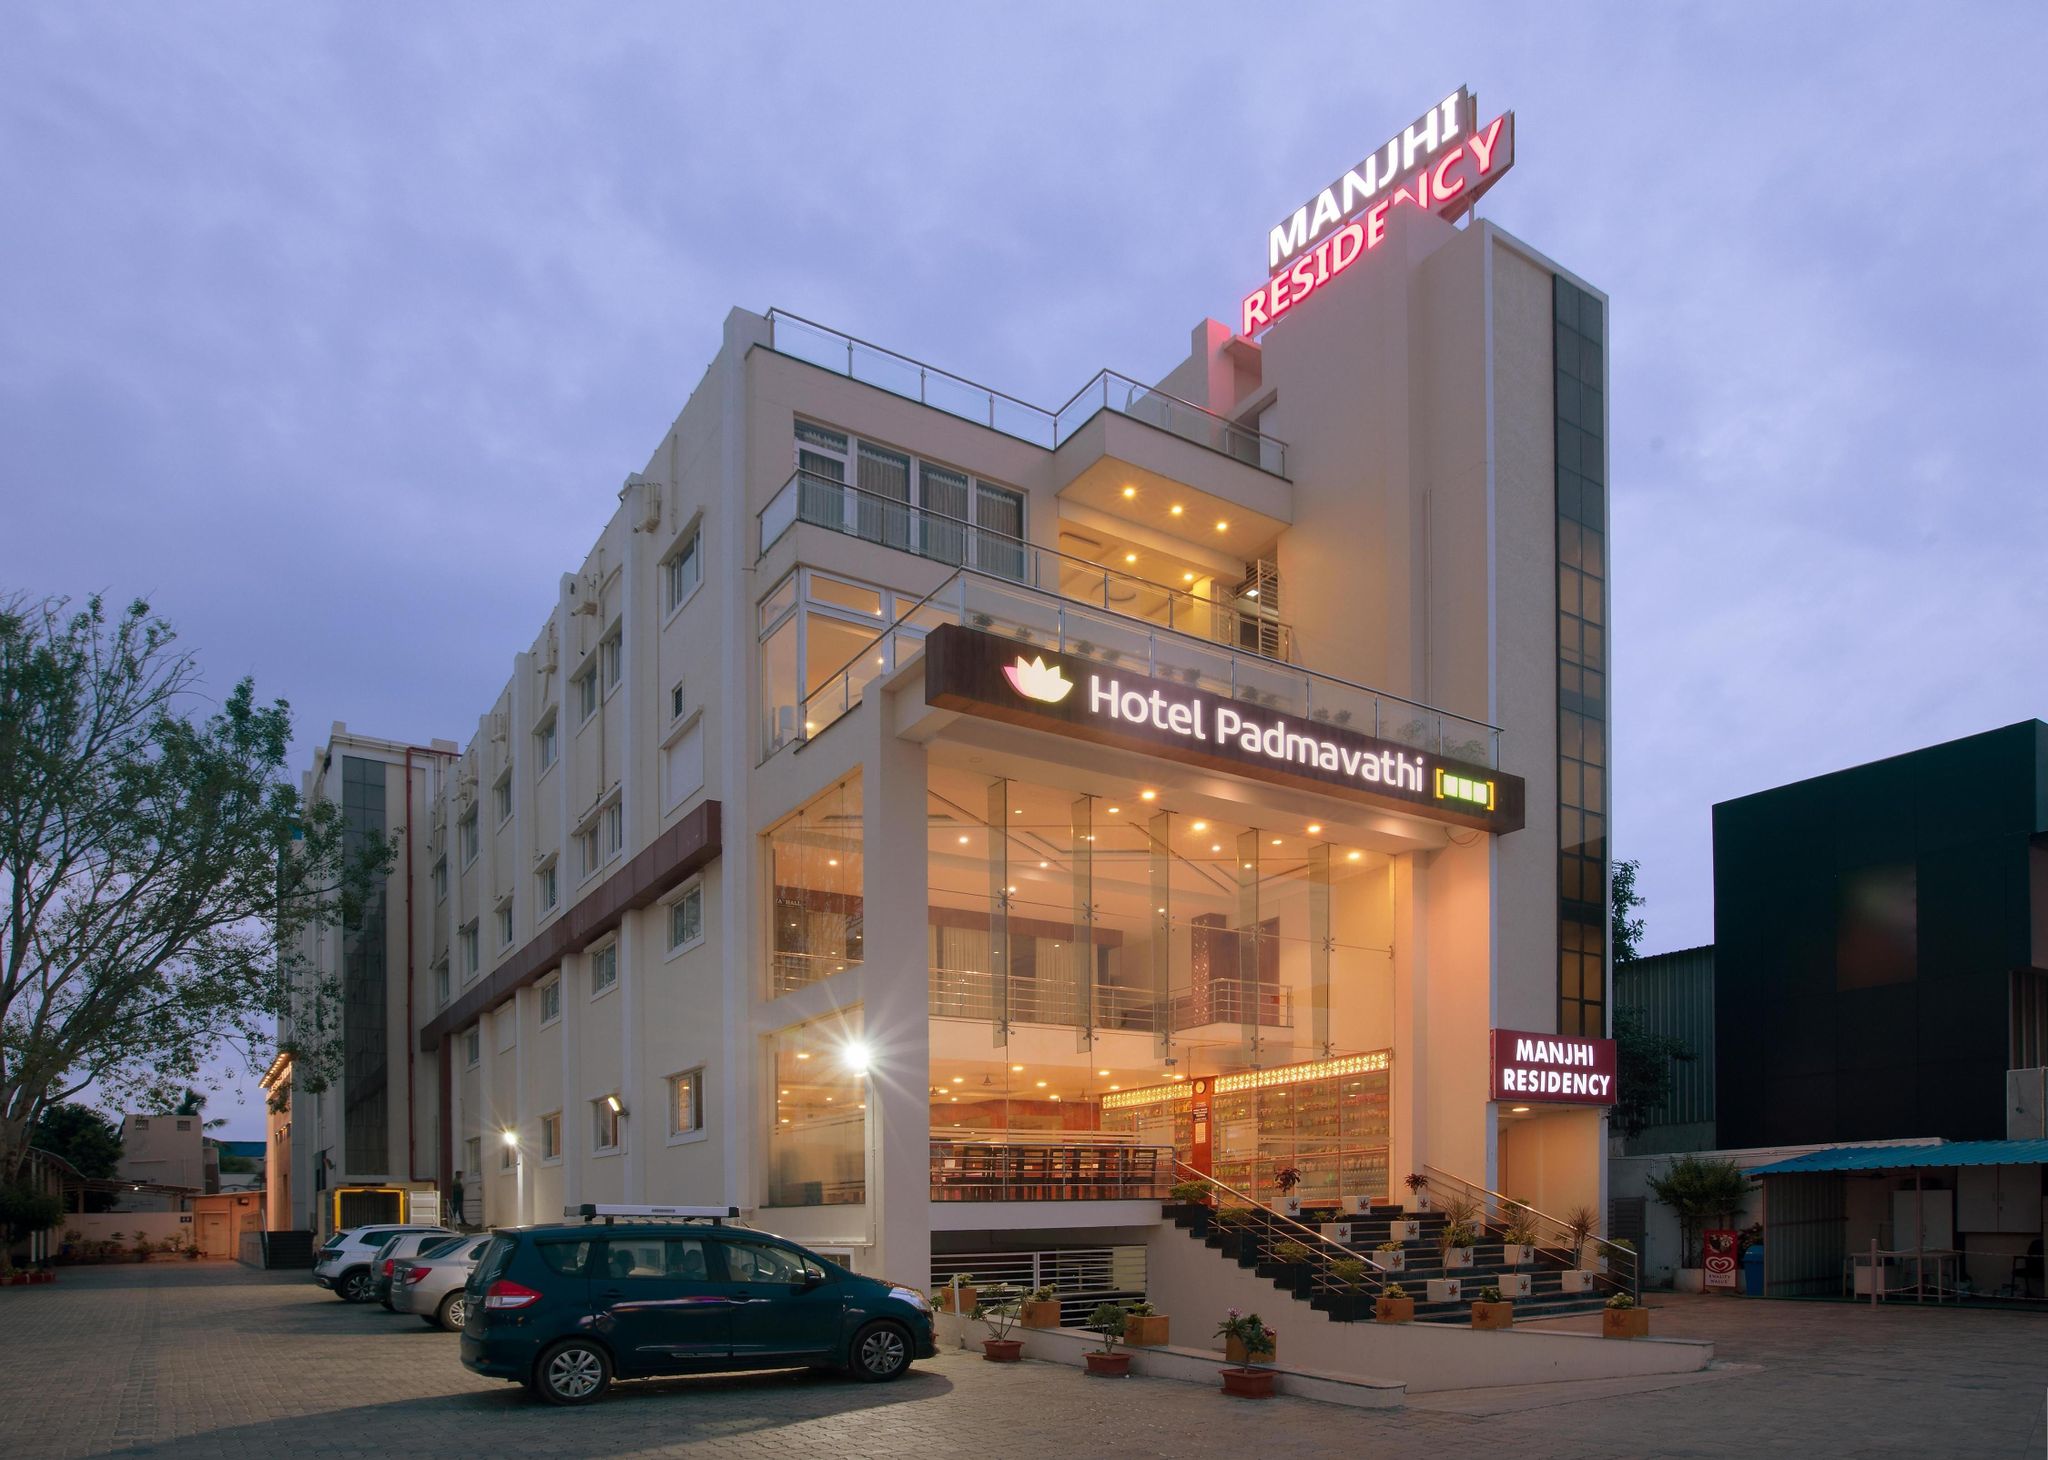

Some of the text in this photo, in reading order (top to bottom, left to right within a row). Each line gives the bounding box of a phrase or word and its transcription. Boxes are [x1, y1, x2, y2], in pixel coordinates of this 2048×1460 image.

[1242, 117, 1504, 337] RESIDENCY
[1269, 92, 1459, 268] MANJHI
[1091, 675, 1424, 792] Hotel Padmavathi
[1503, 1069, 1610, 1095] RESIDENCY
[1516, 1039, 1594, 1066] MANJHI
